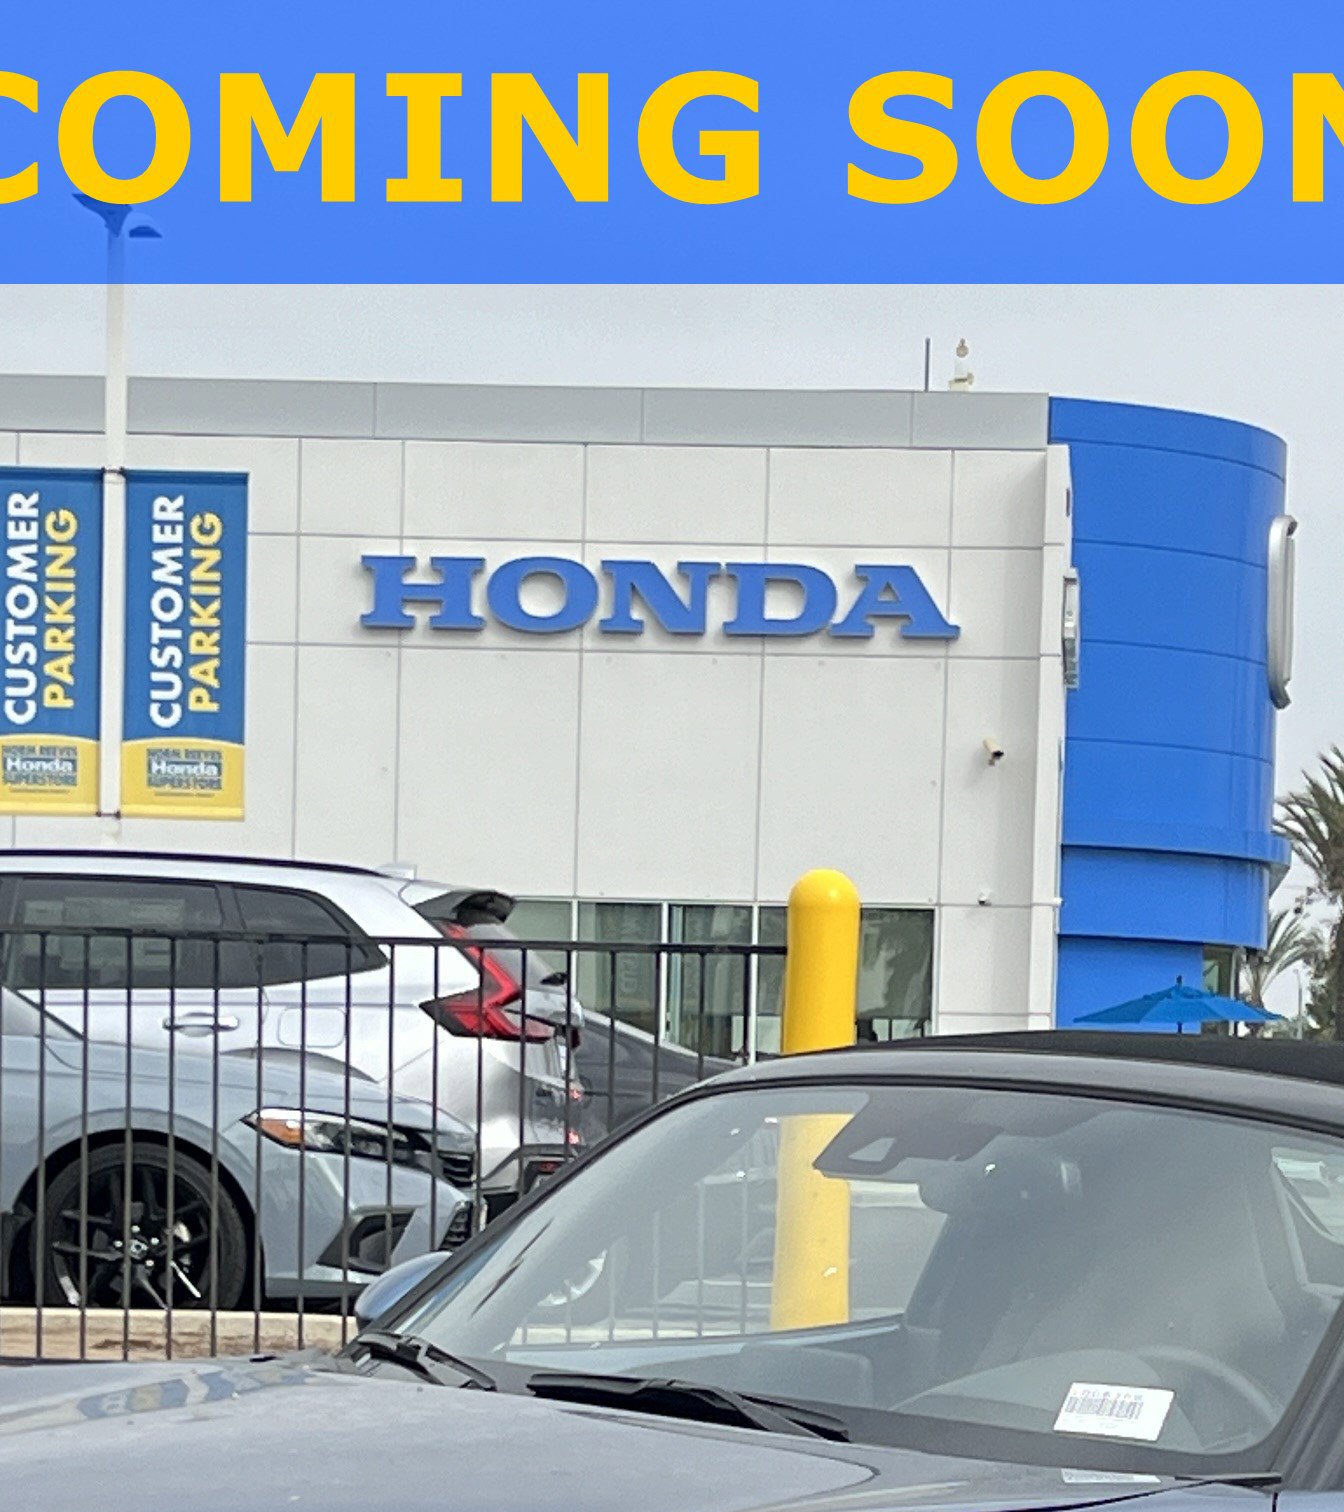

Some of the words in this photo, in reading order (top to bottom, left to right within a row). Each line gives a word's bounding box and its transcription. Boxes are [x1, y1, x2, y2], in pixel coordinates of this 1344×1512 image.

[4, 490, 40, 726] CUSTOMER
[42, 508, 78, 708] PARKING
[149, 494, 185, 729] CUSTOMER
[188, 511, 223, 713] PARKING
[359, 554, 961, 641] HONDA
[6, 757, 73, 772] Honda
[151, 761, 218, 776] Honda
